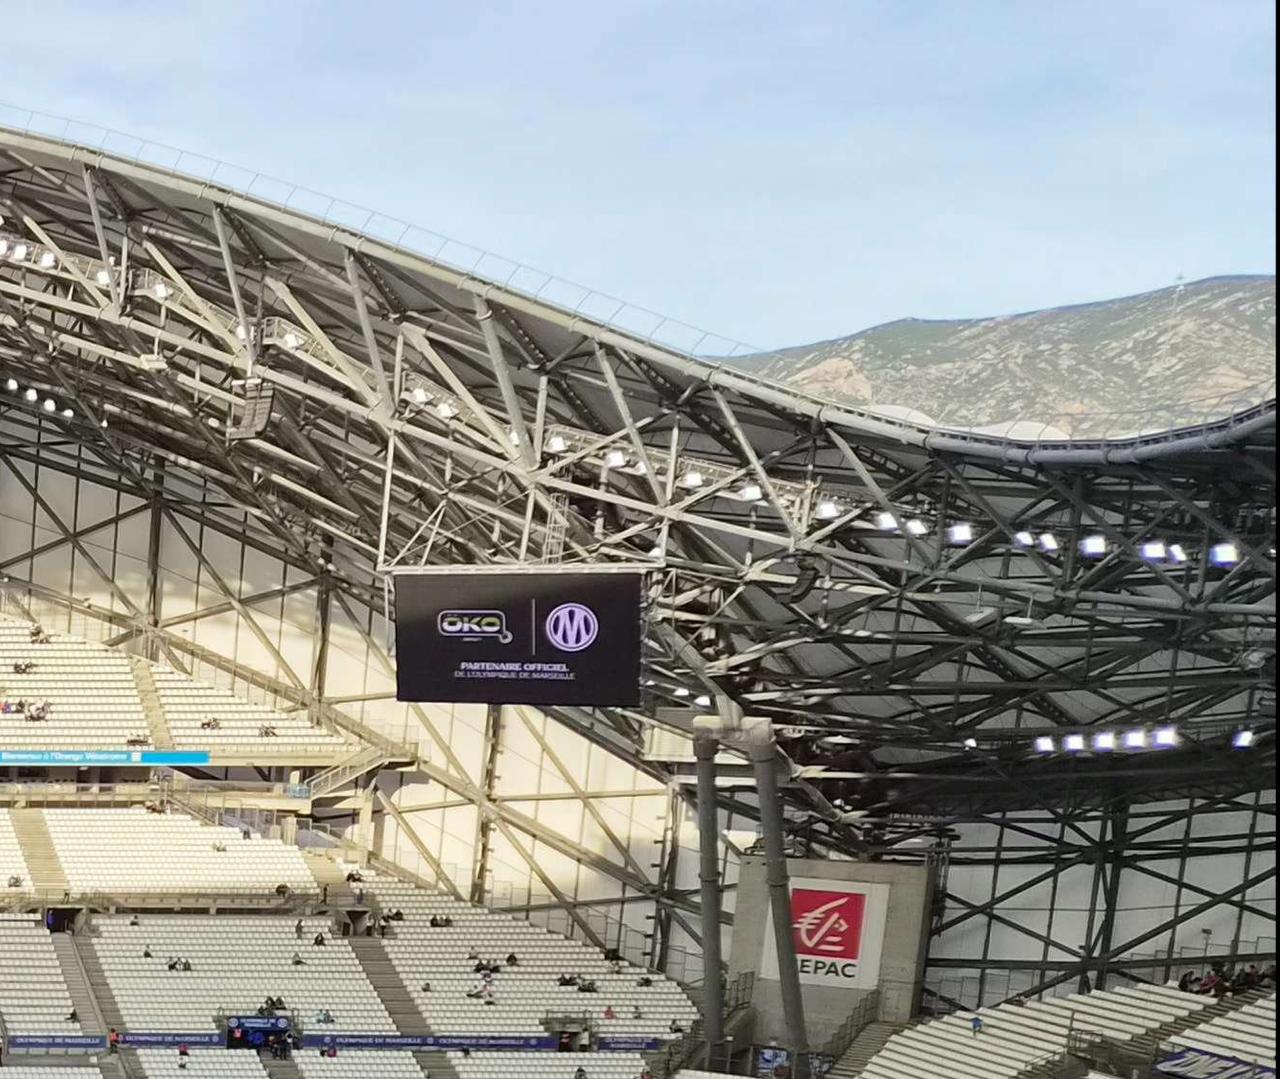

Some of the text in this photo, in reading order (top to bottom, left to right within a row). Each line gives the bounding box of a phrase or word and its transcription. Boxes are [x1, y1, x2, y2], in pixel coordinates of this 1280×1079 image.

[461, 662, 569, 672] PARTENAIRE OFFICIEL
[532, 672, 576, 680] MARSEILLE
[799, 959, 857, 978] EPAC
